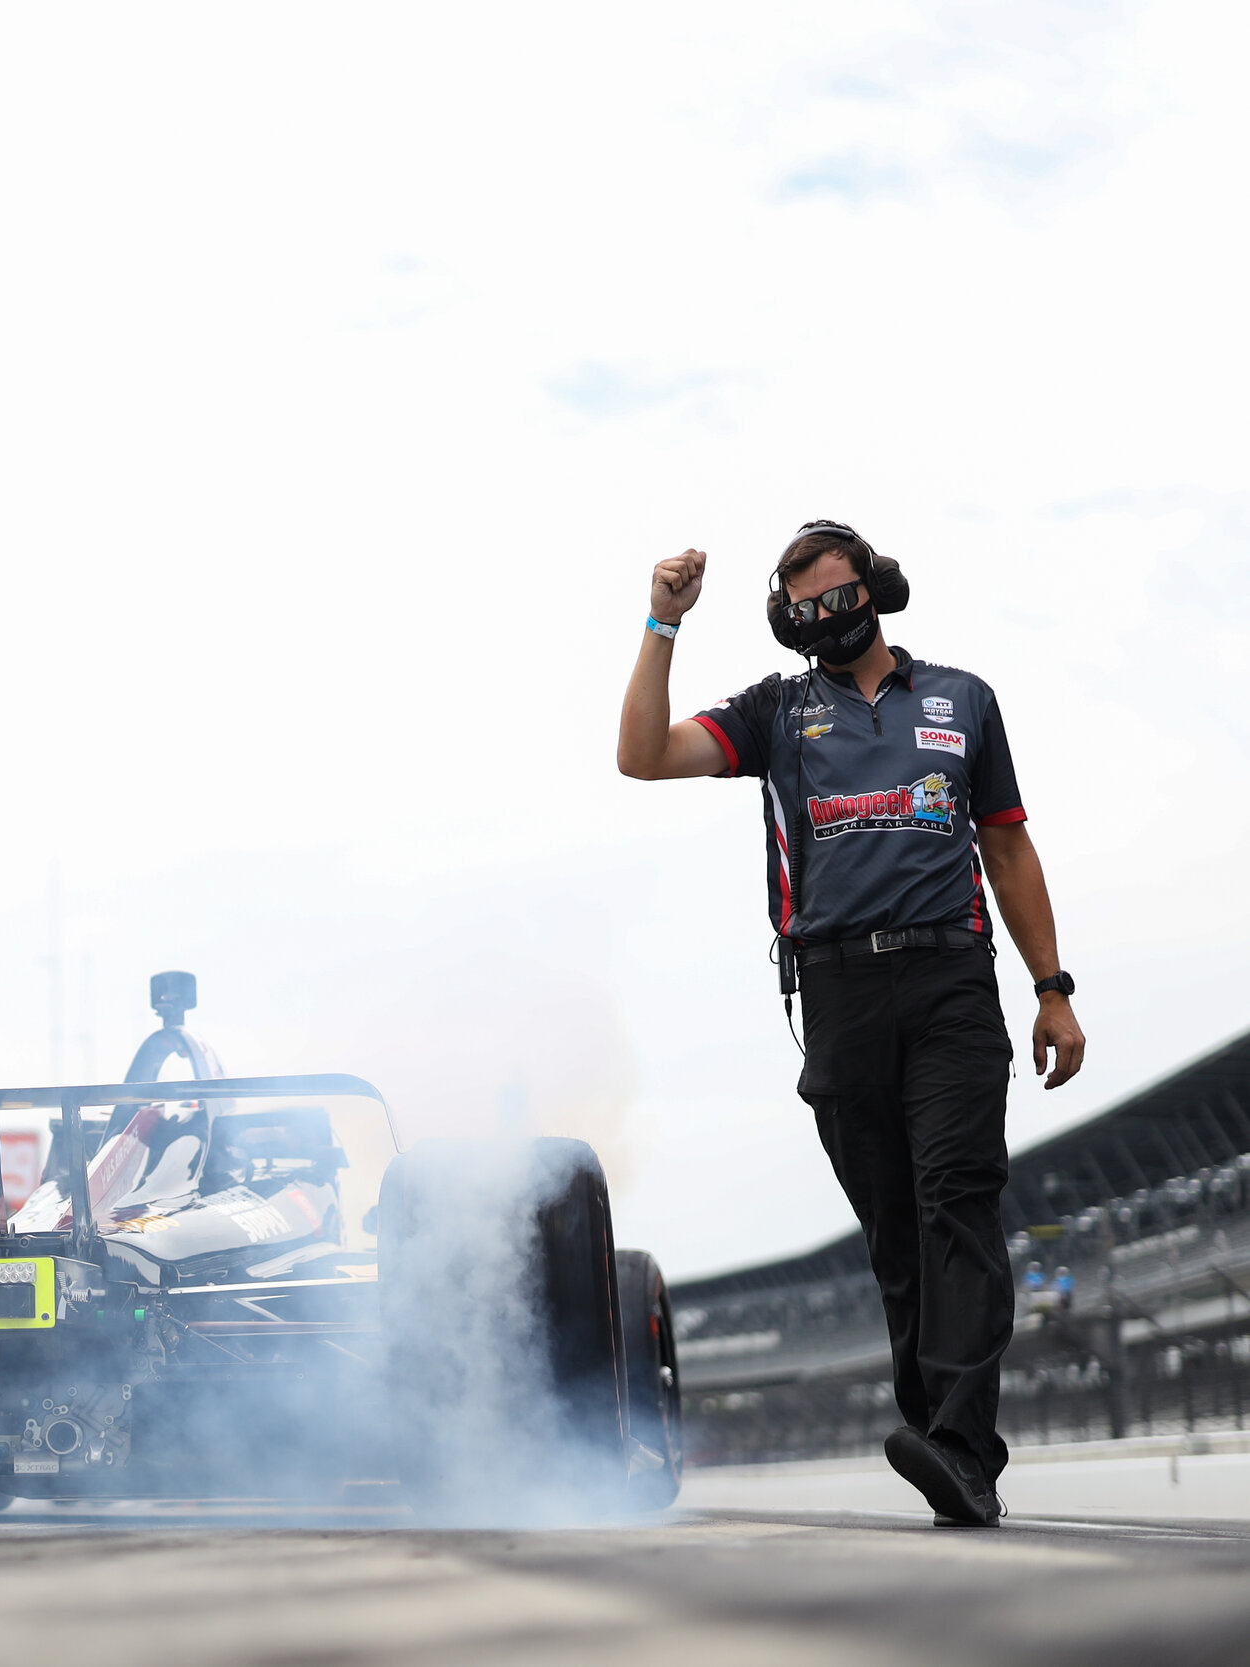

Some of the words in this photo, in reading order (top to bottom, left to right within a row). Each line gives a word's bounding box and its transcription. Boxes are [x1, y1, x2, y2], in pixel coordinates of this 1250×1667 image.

[923, 707, 954, 715] INDYCAR
[920, 730, 963, 746] SONAX
[810, 787, 915, 826] Autogeek
[821, 827, 838, 837] WE
[842, 821, 866, 831] ARE
[874, 820, 903, 828] CAR
[910, 820, 945, 831] CARE
